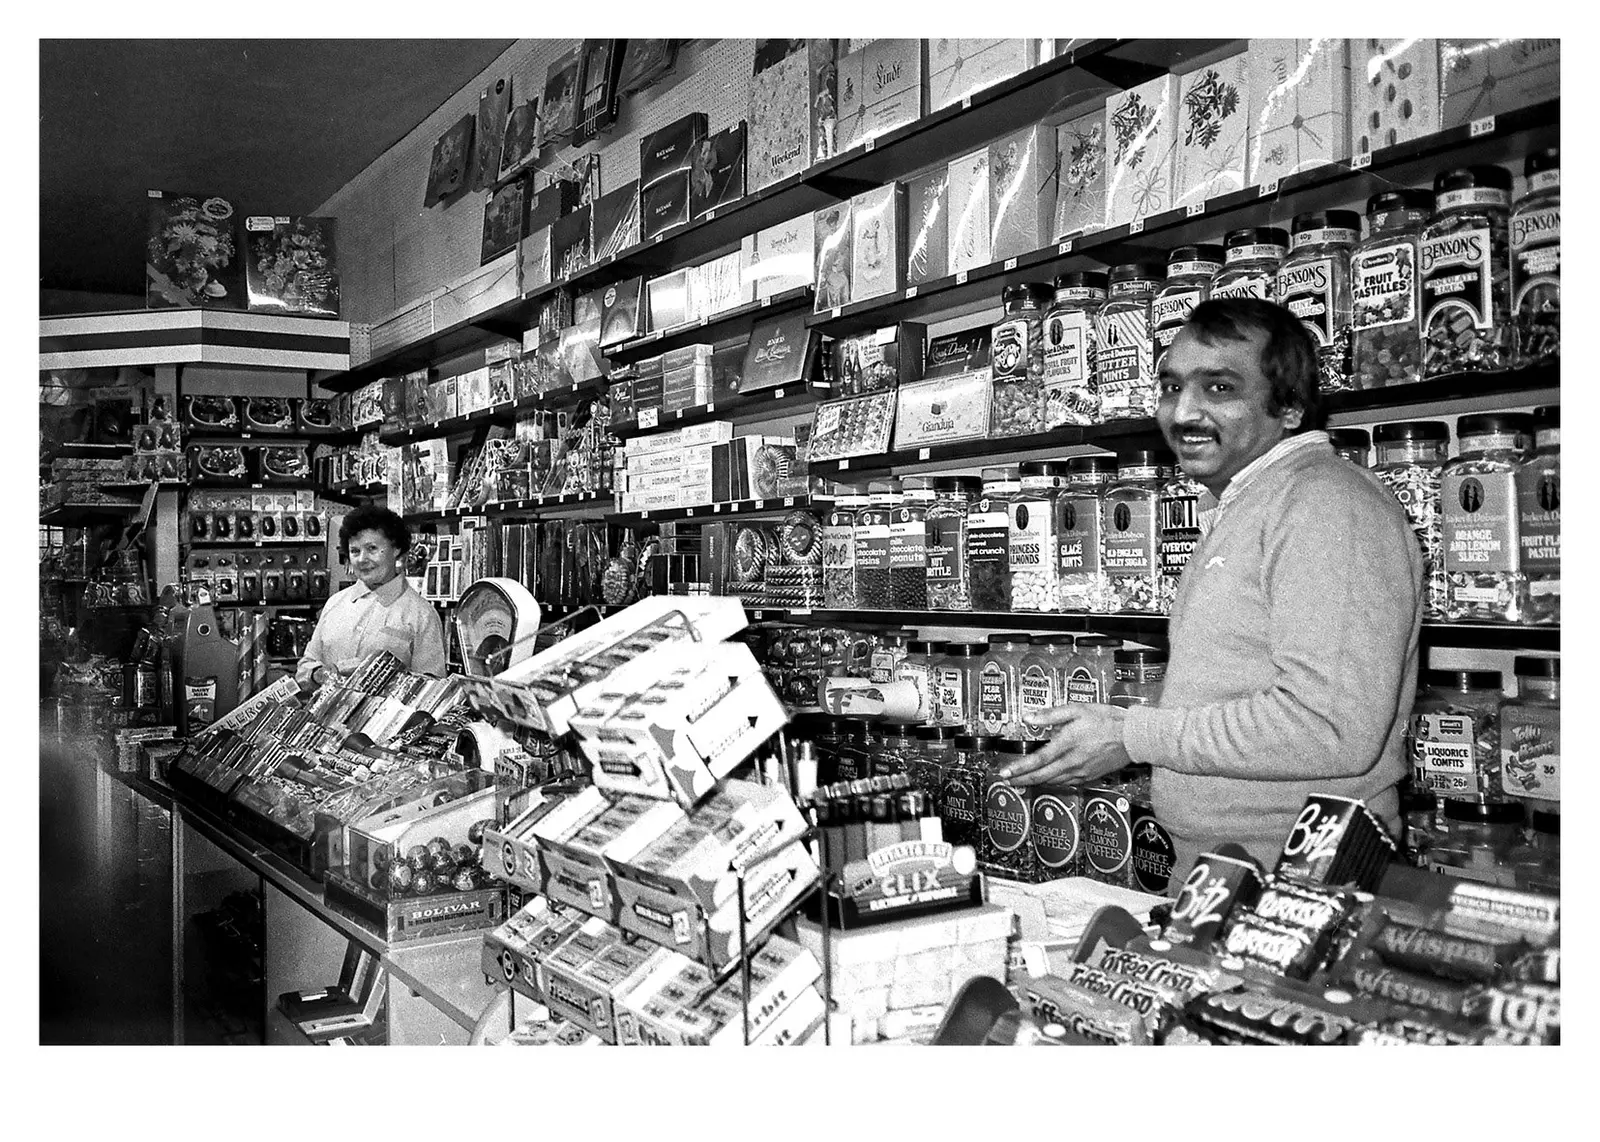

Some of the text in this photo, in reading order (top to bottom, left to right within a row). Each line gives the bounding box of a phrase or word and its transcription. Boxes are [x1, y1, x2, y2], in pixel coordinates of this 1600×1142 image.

[771, 146, 801, 168] Weekend
[1421, 236, 1482, 270] BENSONS
[1278, 265, 1327, 296] BENSONS
[1363, 271, 1394, 287] FRUIT
[1353, 281, 1407, 300] PASTILLES
[1153, 297, 1194, 325] BENSONS
[1102, 369, 1130, 382] MINTS
[922, 419, 954, 433] Gianduja
[890, 537, 903, 546] milk
[980, 531, 1005, 540] chocolate
[1455, 529, 1492, 541] ORANGE
[1522, 535, 1543, 546] FRUIT
[857, 548, 887, 557] chocolate
[890, 544, 924, 554] chocolate
[979, 546, 1005, 556] crunch
[1010, 543, 1040, 555] PRINCESS
[1061, 540, 1083, 556] GLACÉ
[1117, 548, 1143, 558] ENGLISH
[1450, 540, 1467, 552] AND
[857, 556, 880, 565] raisins
[890, 552, 924, 564] peanuts
[1125, 557, 1148, 567] SUGAR
[1459, 550, 1489, 562] SLICES
[1428, 747, 1469, 758] LIQUORICE
[1431, 757, 1464, 768] COMFITS
[947, 795, 966, 809] MINT
[944, 804, 975, 822] TOFFEES
[988, 818, 1024, 835] TOFFEES
[1034, 823, 1068, 839] TREACLE
[1033, 832, 1071, 851] TOFFEES
[1090, 834, 1119, 848] ALMOND
[1087, 842, 1124, 861] TOFFEES
[1136, 846, 1169, 866] LICORICE
[1134, 855, 1173, 878] TOFFEES
[881, 869, 941, 897] CLIX
[412, 900, 481, 919] BOLIVAR
[752, 989, 788, 1026] rbit
